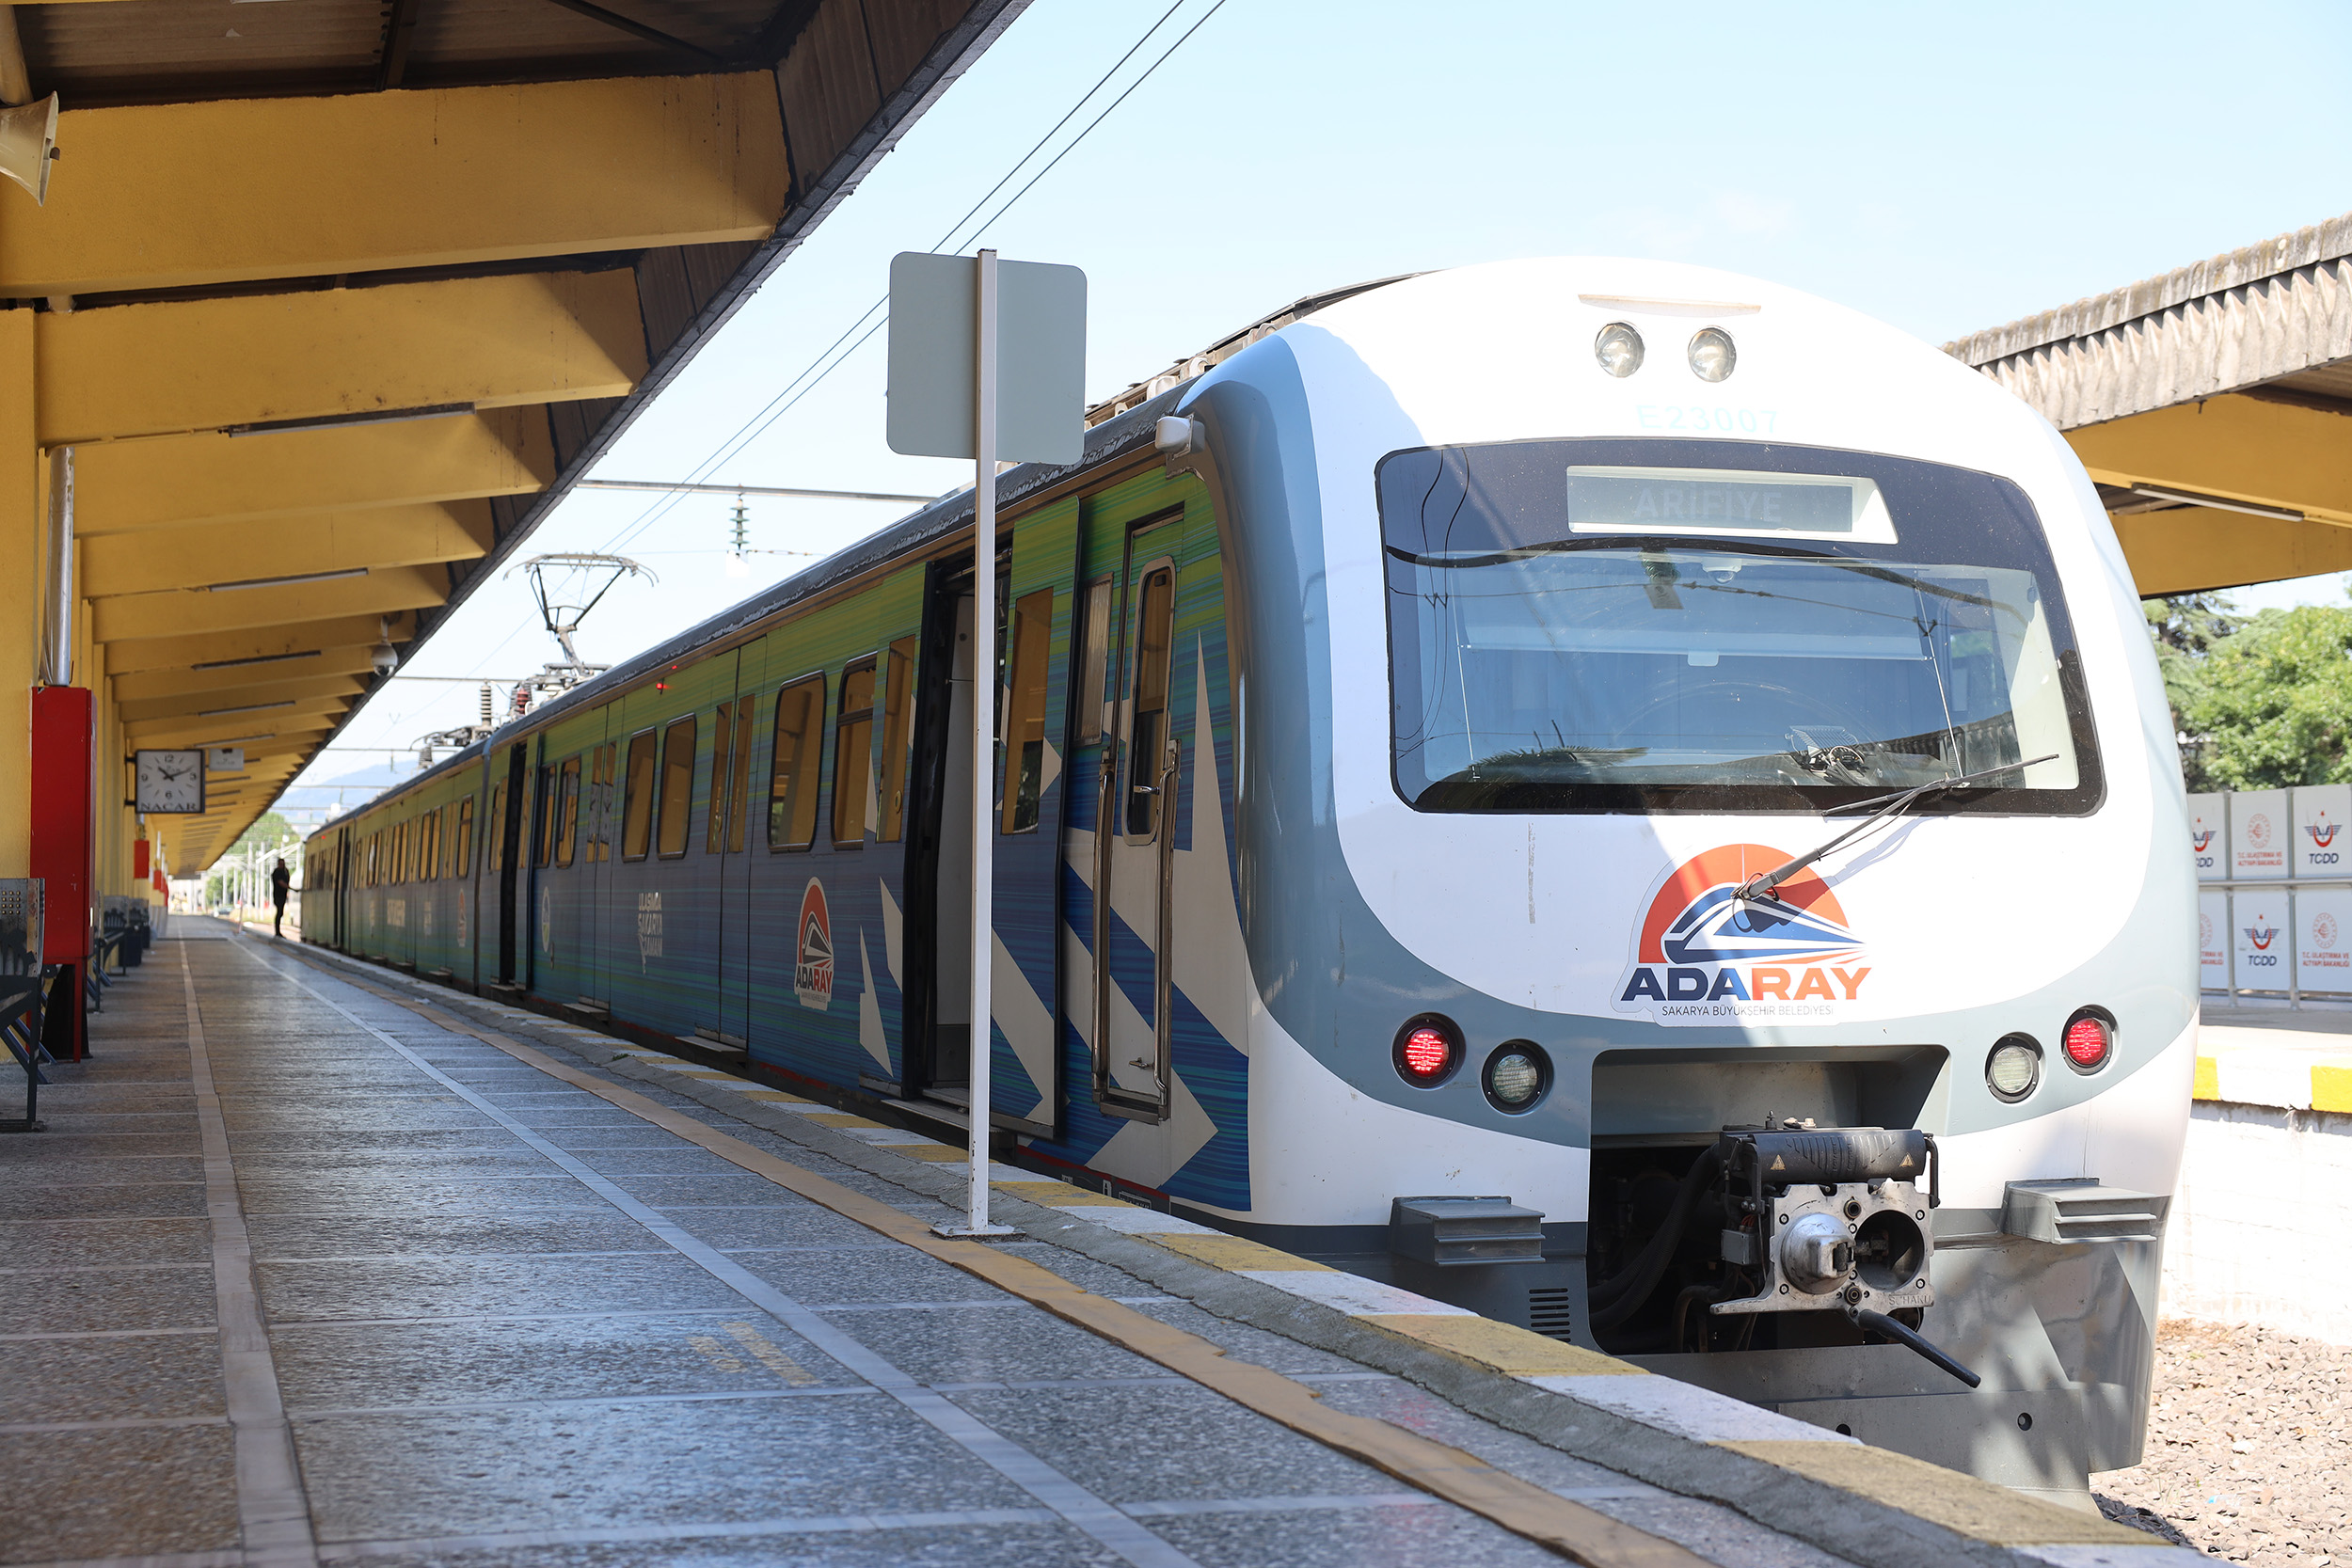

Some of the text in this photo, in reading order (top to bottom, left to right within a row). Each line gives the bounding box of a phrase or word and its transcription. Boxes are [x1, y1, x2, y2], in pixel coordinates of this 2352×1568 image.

[1635, 404, 1778, 434] E23007
[1633, 482, 1782, 523] ARİFİYE
[164, 753, 175, 764] 12
[141, 773, 149, 782] 9
[189, 772, 197, 782] 3
[165, 790, 172, 800] 6
[140, 802, 197, 812] NACAR
[2309, 852, 2340, 864] TCDD
[2248, 955, 2278, 967] TCDD
[795, 965, 834, 994] ADARAY
[1621, 967, 1872, 1002] ADARAY
[1661, 1006, 1709, 1016] SAKARYA
